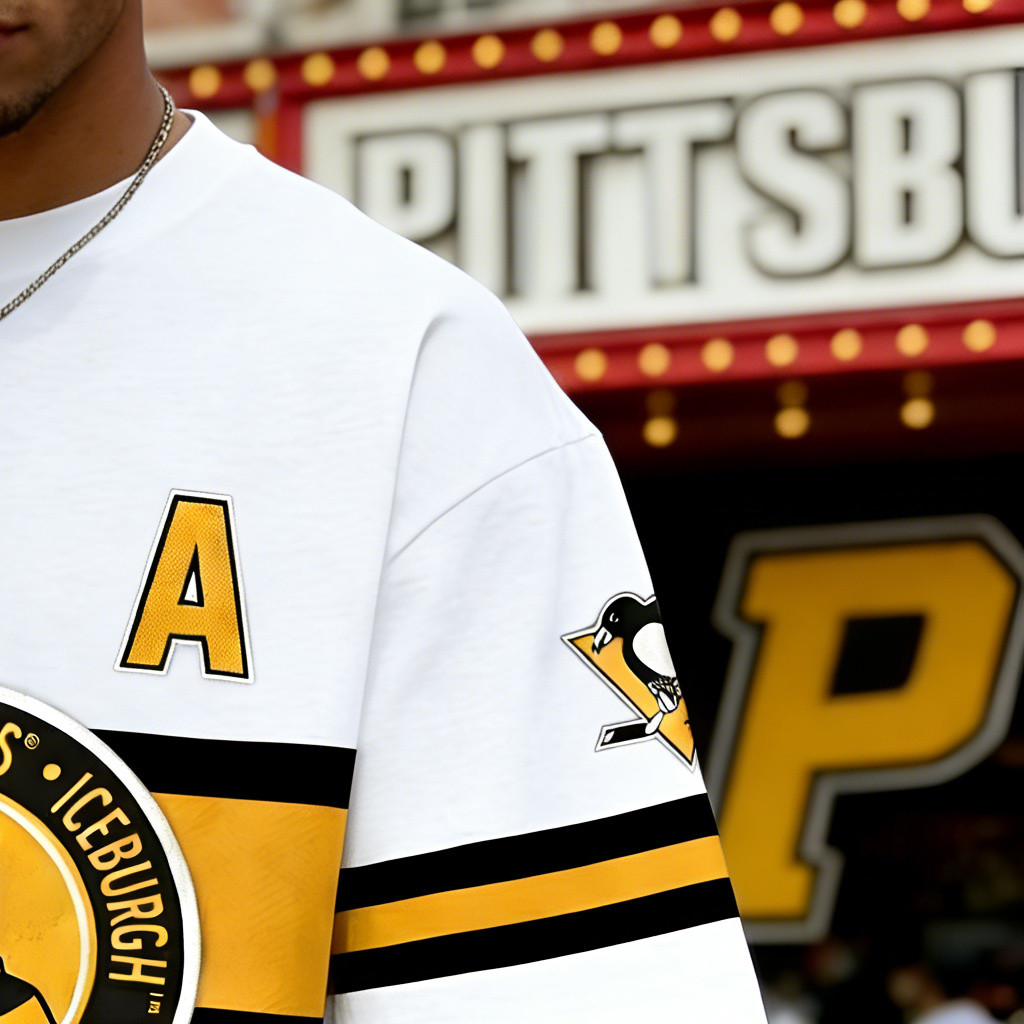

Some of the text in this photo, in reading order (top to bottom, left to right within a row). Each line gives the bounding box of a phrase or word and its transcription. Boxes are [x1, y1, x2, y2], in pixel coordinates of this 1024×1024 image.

[118, 492, 251, 681] A
[704, 514, 1024, 943] P
[50, 771, 169, 986] ICEBURGH
